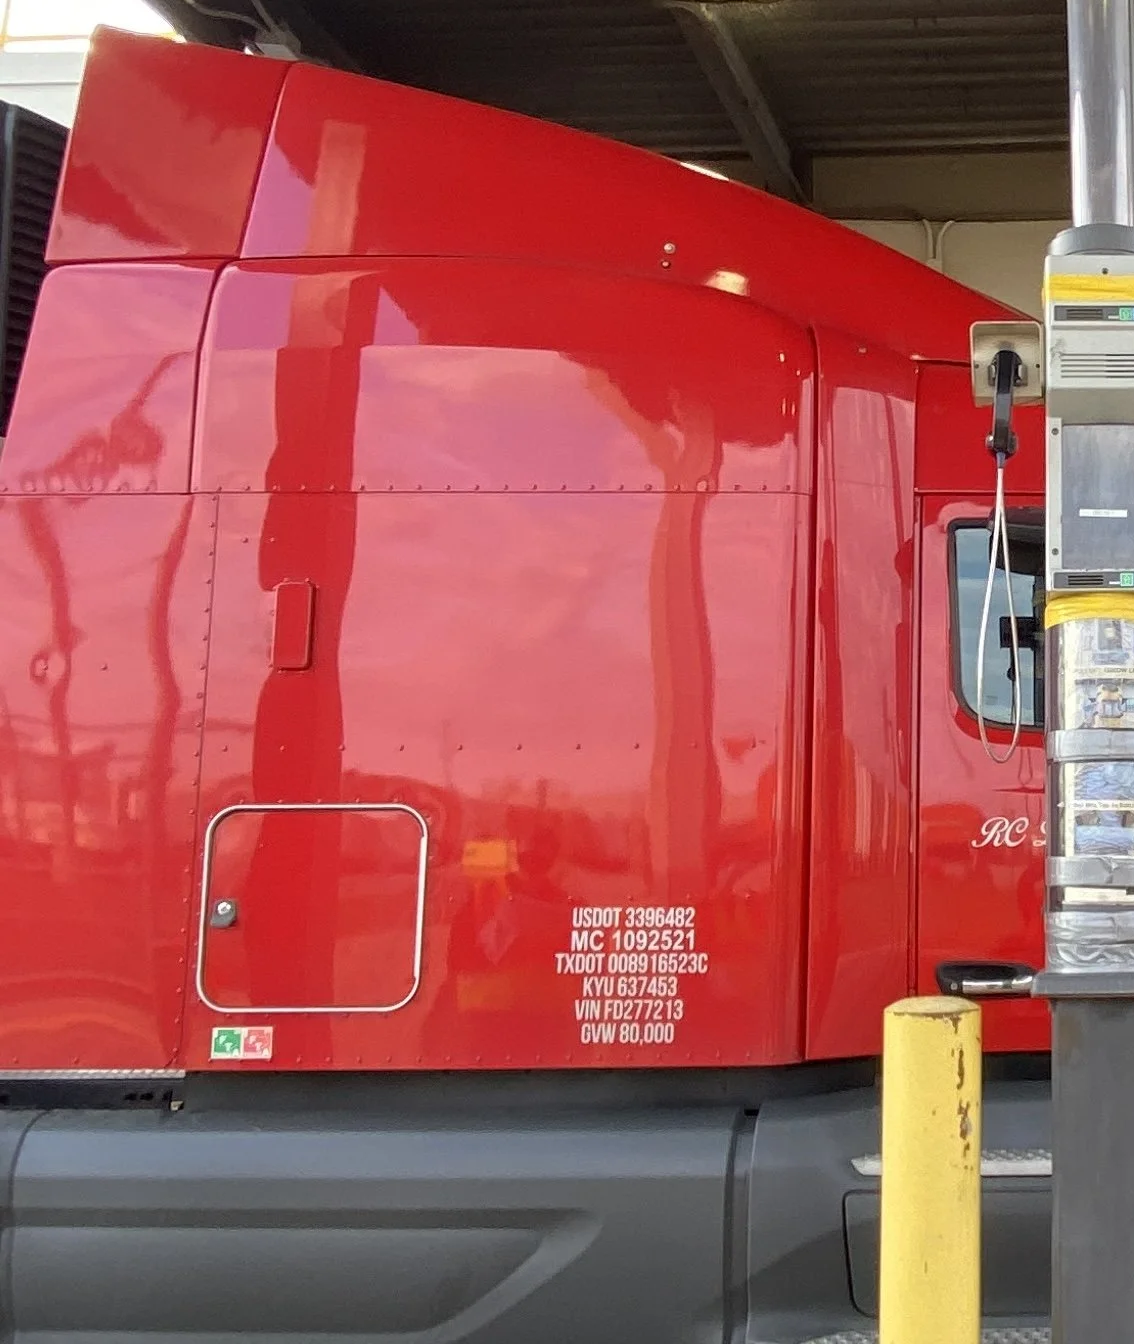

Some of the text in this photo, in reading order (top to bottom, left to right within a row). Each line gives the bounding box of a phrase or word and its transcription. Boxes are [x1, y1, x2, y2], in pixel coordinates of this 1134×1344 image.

[971, 816, 1029, 848] RC
[572, 906, 696, 928] USDOT 3396482
[571, 929, 695, 951] MC 1092521
[554, 952, 708, 974] TXDOT 008916523C
[583, 976, 678, 997] KYU 637453
[575, 999, 684, 1021] VIN FD277213
[581, 1022, 675, 1046] GVW 80,000
